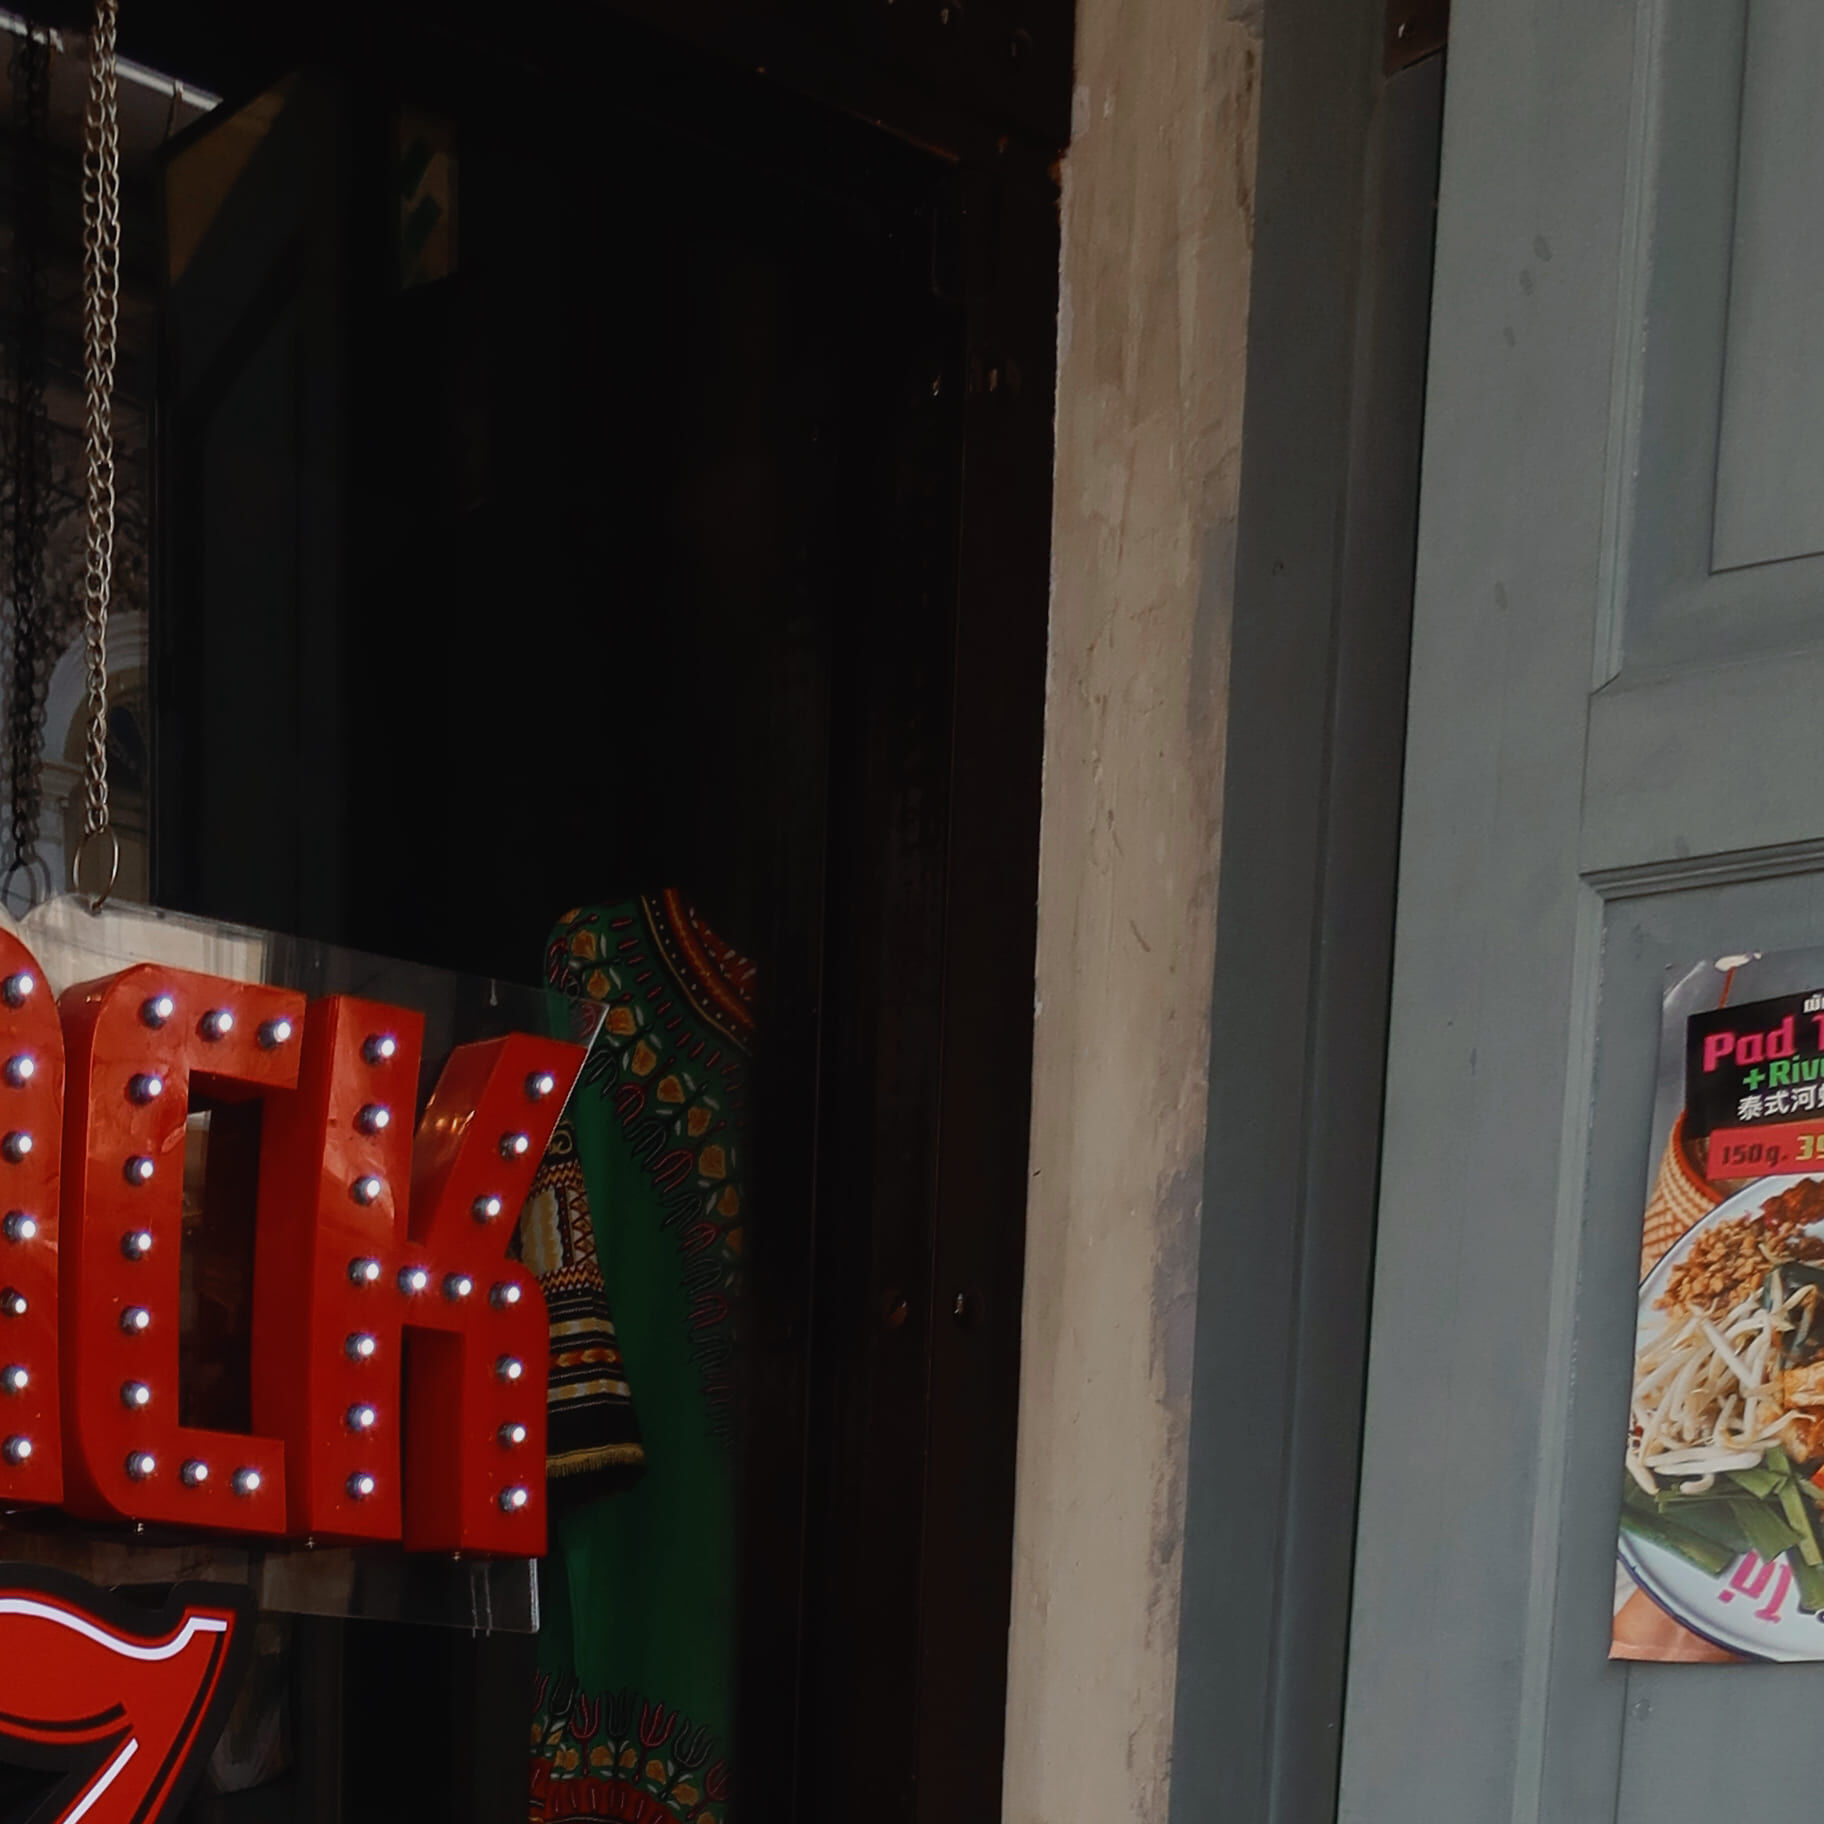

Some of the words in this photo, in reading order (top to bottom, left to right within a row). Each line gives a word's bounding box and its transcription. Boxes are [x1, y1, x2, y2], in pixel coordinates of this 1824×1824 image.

[1703, 1014, 1796, 1073] Pad
[1742, 1054, 1824, 1091] +Riv
[1737, 1083, 1824, 1122] 泰式河
